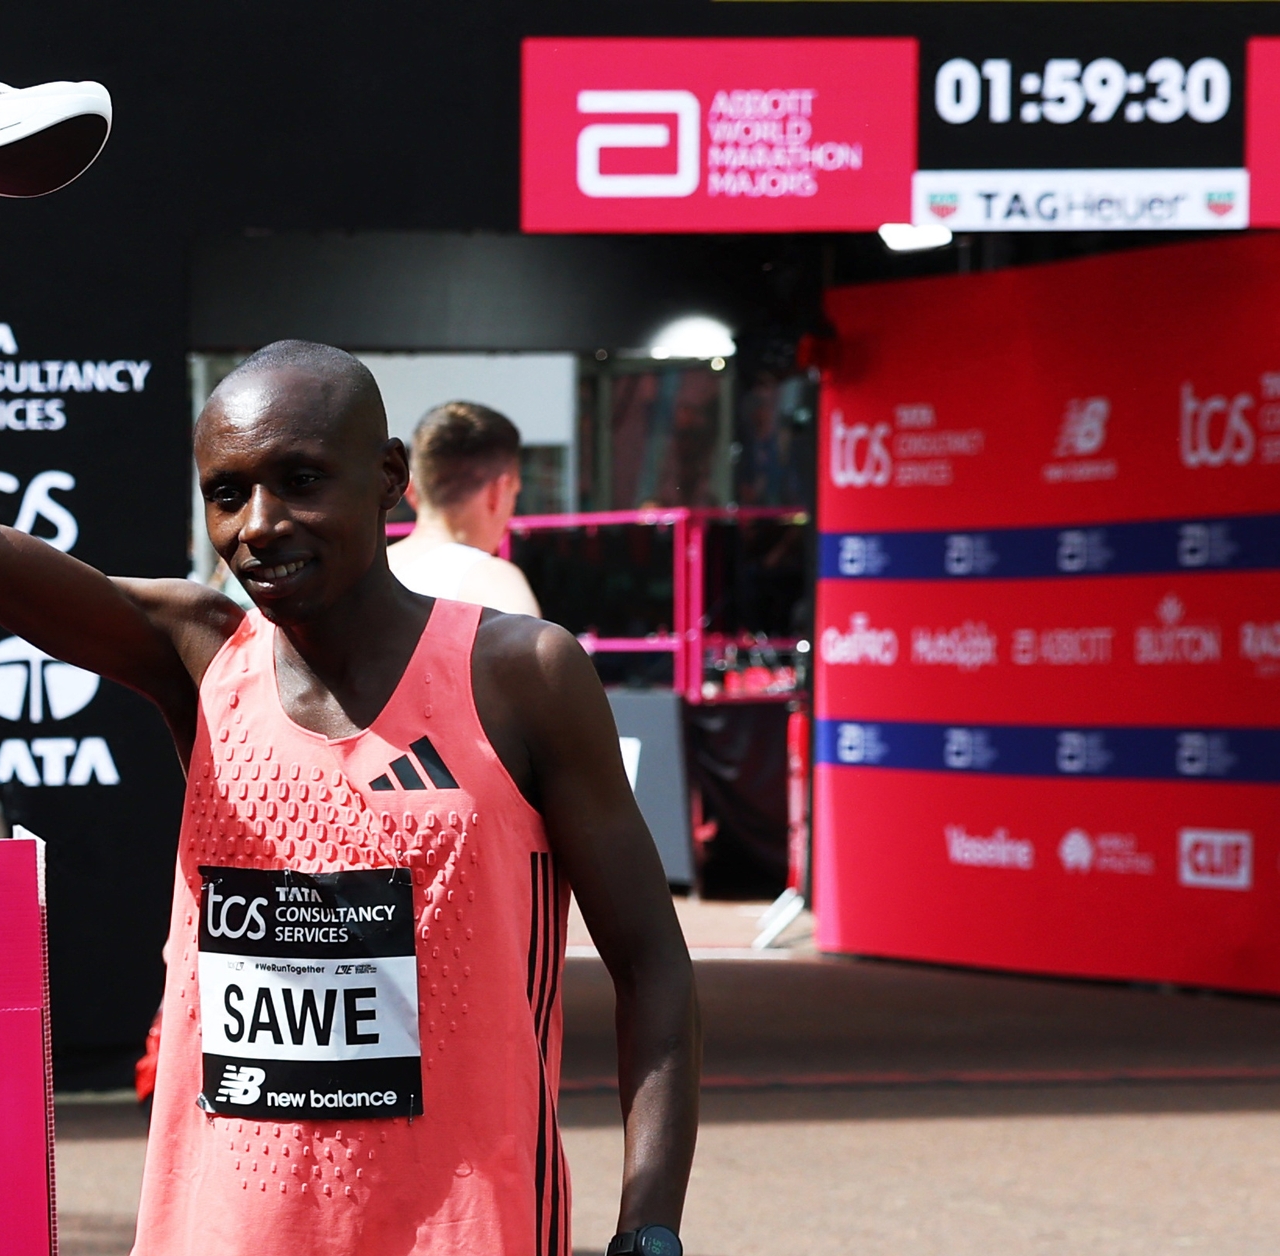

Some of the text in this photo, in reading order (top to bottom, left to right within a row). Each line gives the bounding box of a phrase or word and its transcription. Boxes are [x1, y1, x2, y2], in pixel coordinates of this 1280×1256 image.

[934, 57, 1231, 124] 01:59:30
[708, 117, 812, 146] WORLD
[1180, 383, 1255, 467] tcs
[831, 407, 890, 487] tcs
[275, 887, 322, 902] TATA
[207, 883, 268, 940] tcs
[275, 905, 396, 923] CONSULTANCY
[275, 928, 348, 942] SERVICES
[255, 963, 325, 975] #WeRunTogether
[224, 984, 380, 1046] SAWE
[267, 1089, 397, 1107] new balance
